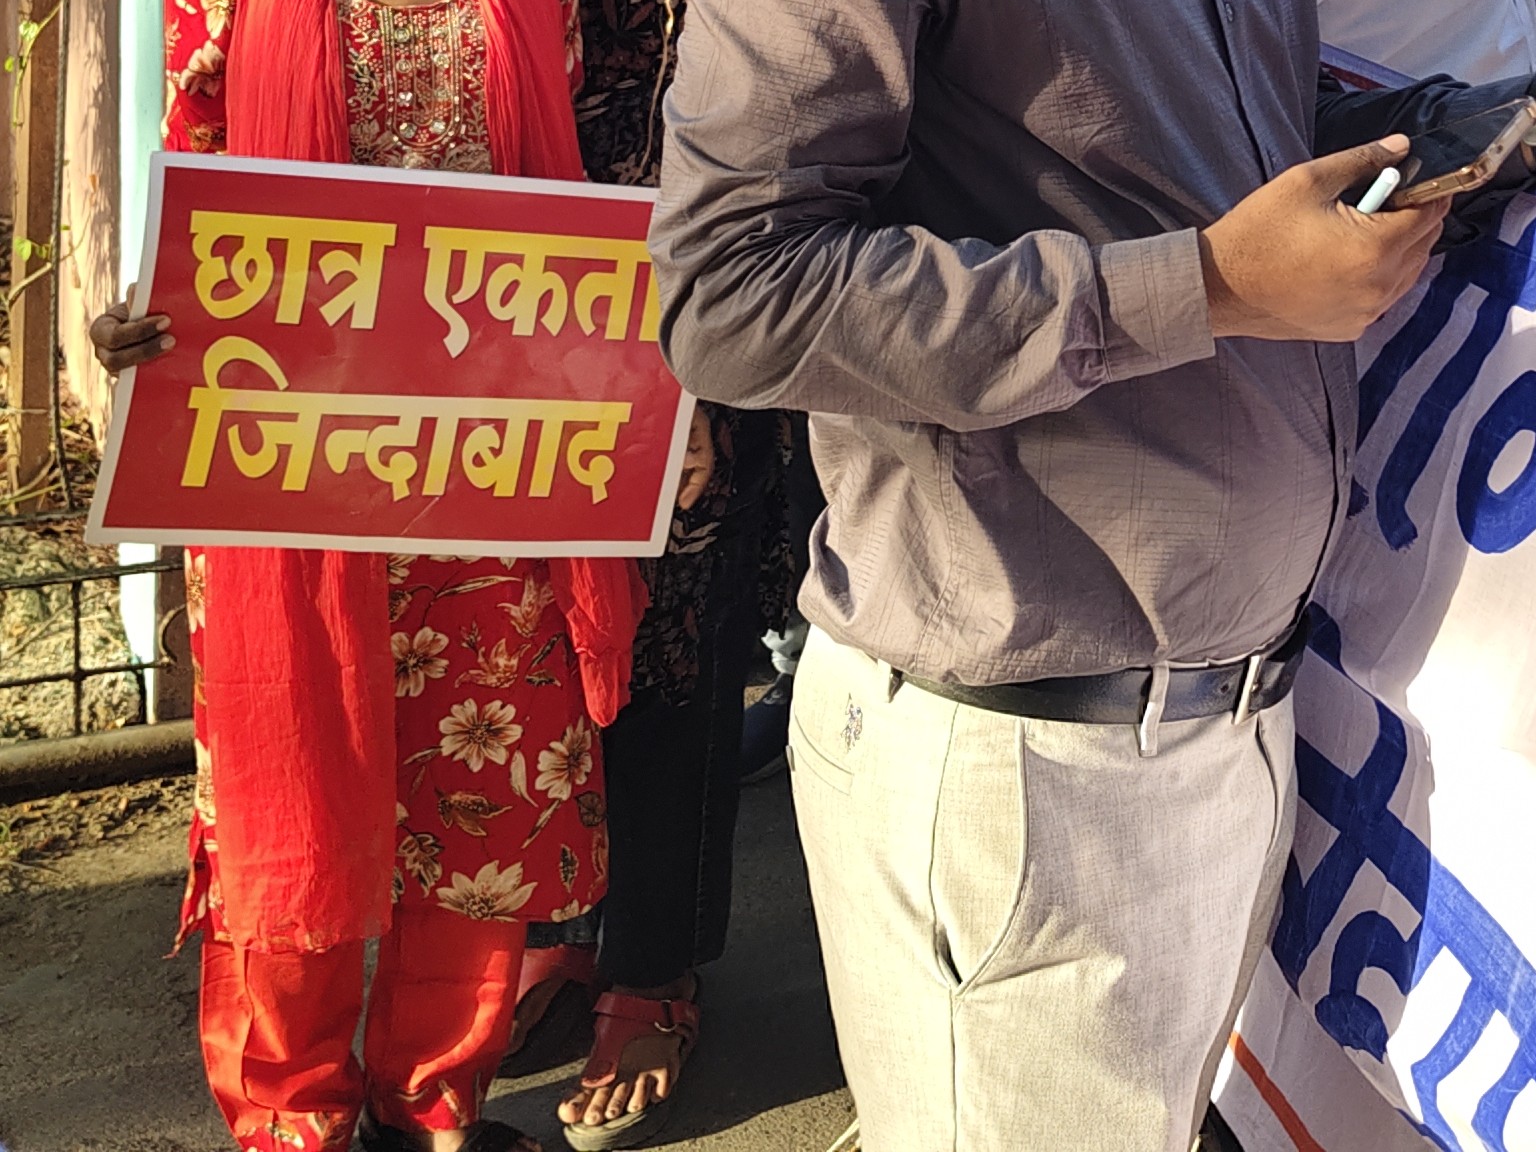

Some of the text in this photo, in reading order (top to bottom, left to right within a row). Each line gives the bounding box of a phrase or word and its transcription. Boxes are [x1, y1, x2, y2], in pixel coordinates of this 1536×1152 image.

[190, 210, 660, 359] छात्र एकता
[181, 335, 632, 505] जिन्दाबाद
